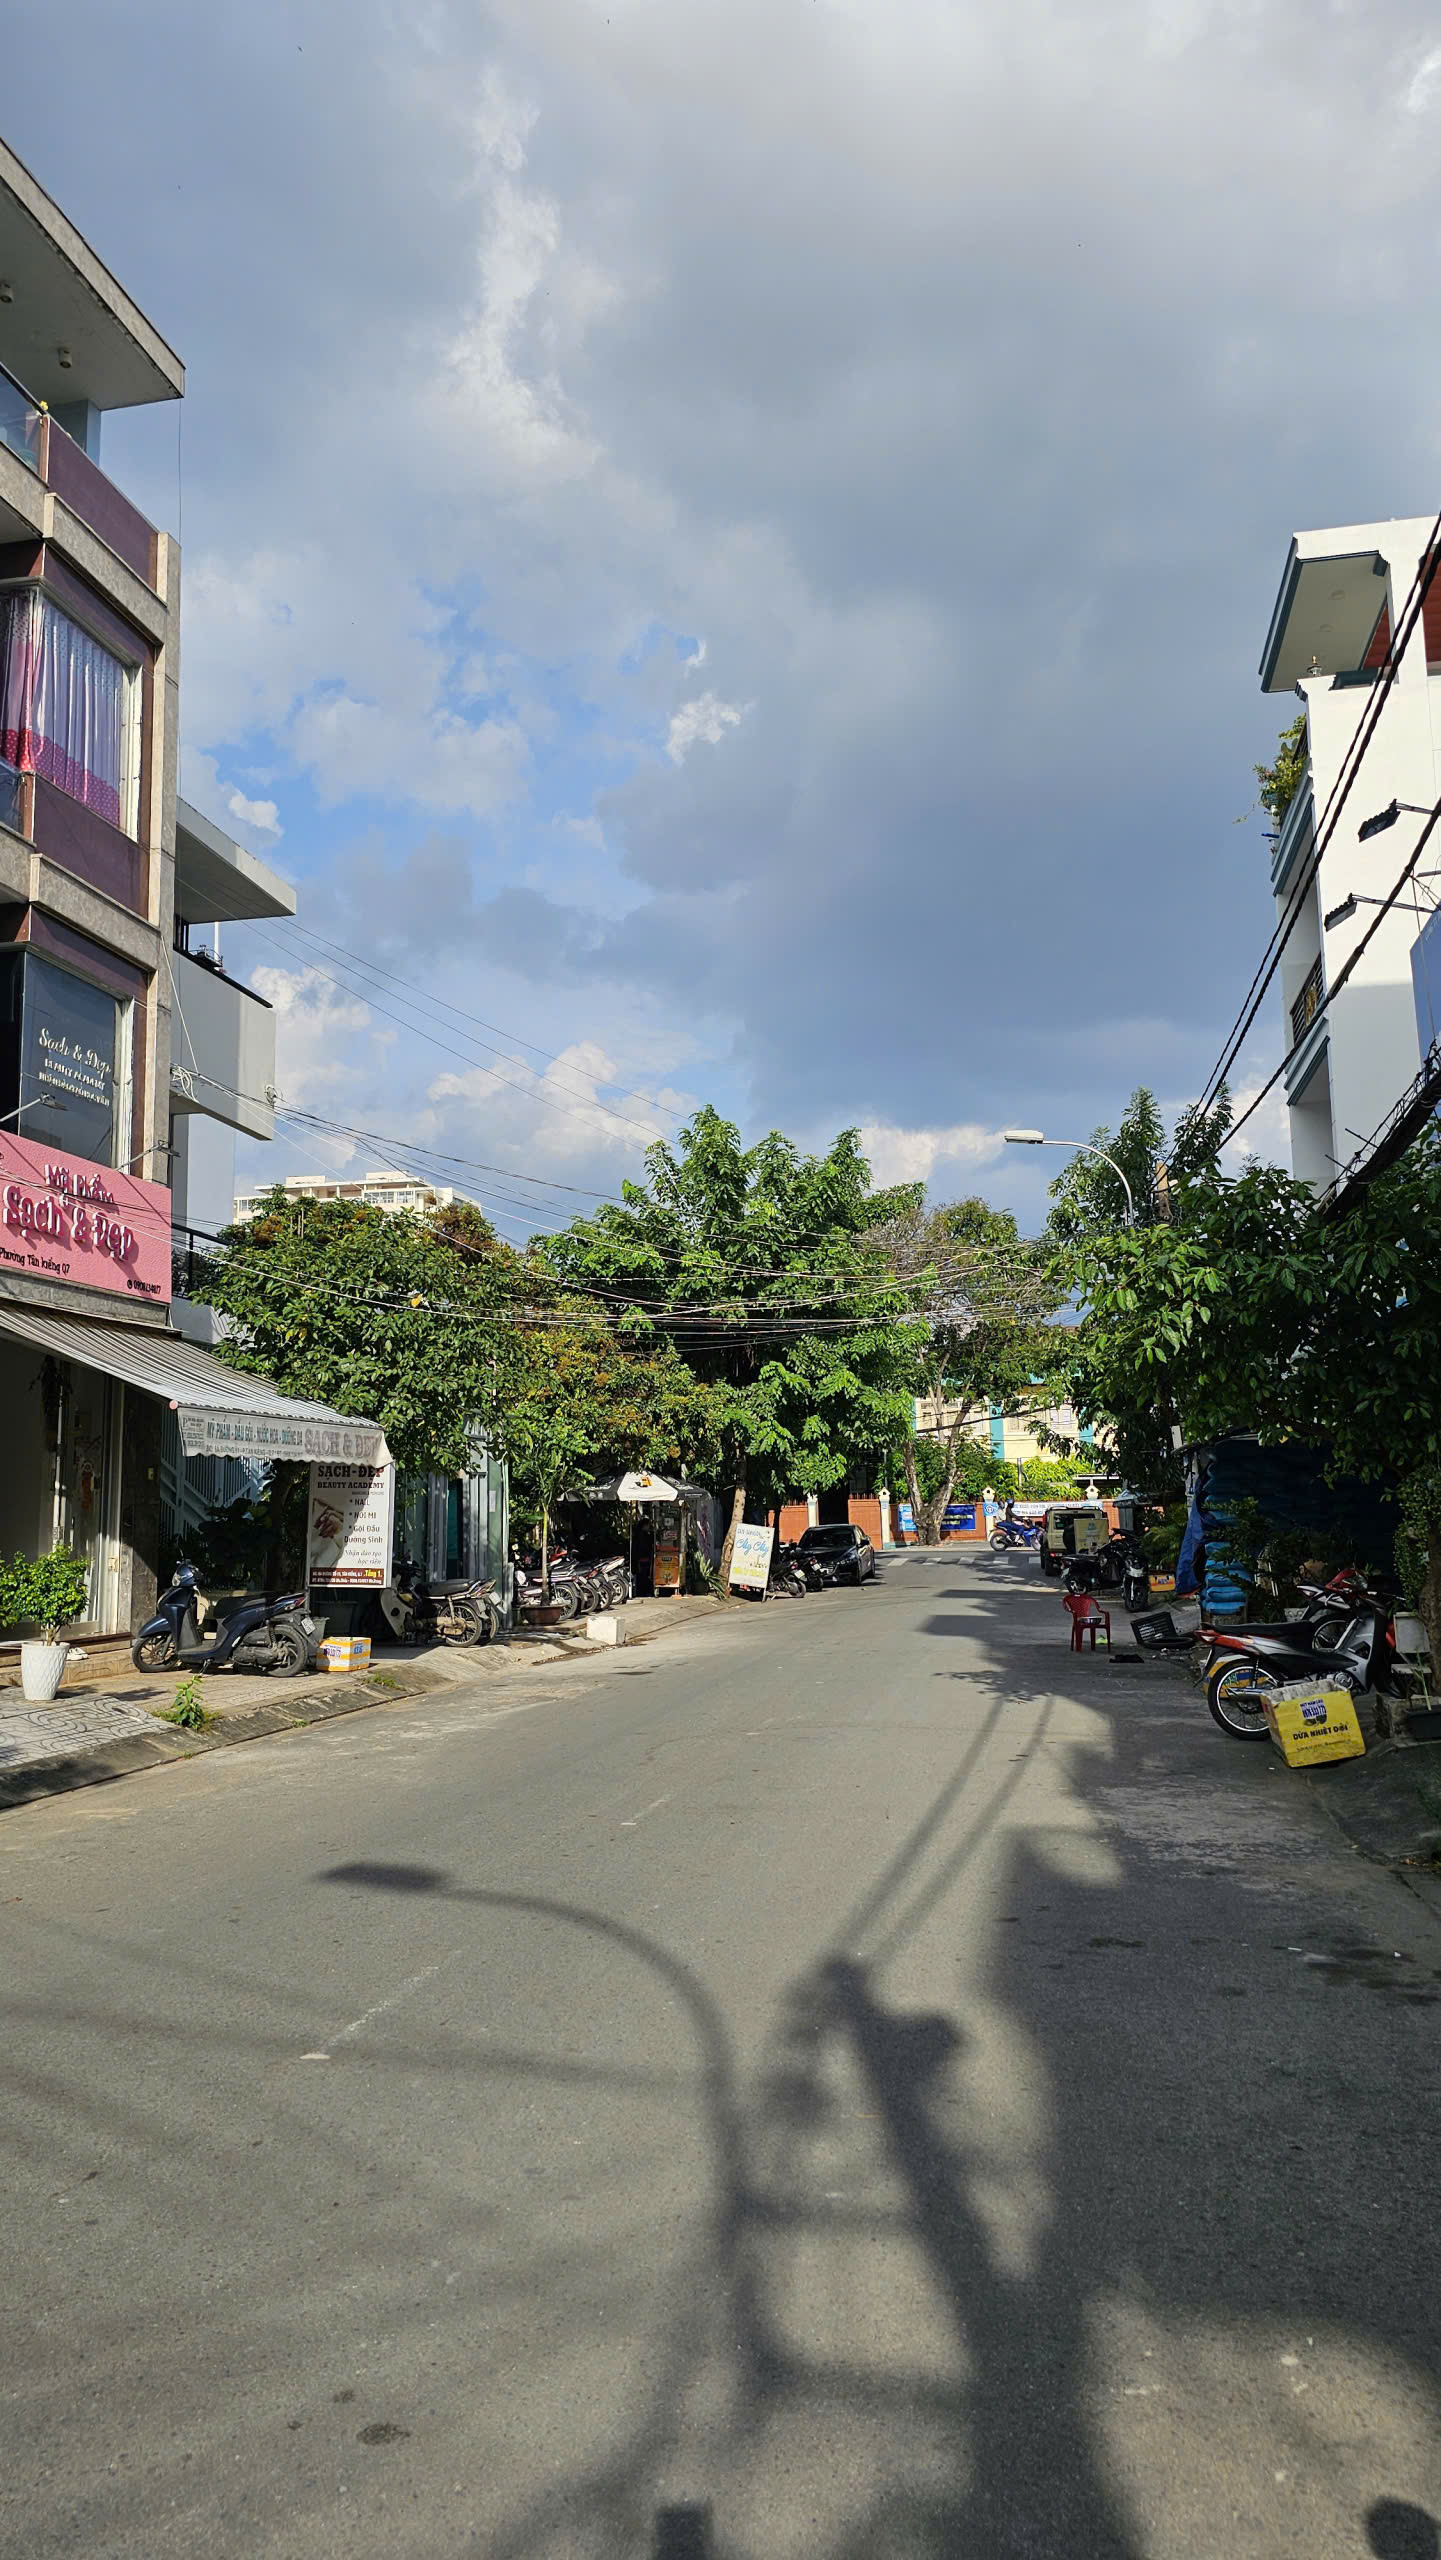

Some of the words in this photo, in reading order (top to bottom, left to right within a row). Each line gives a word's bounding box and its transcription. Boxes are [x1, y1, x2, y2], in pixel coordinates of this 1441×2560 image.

[73, 1045, 83, 1061] &
[44, 1164, 70, 1206] Mỹ
[73, 1173, 115, 1203] Phẩm
[3, 1185, 65, 1237] Sạch
[71, 1207, 88, 1241] &
[91, 1211, 134, 1260] Đẹp
[342, 1432, 354, 1458] &
[317, 1481, 346, 1489] BEAUTY
[347, 1481, 385, 1489] ACADEMY
[367, 1535, 383, 1544] Sinh
